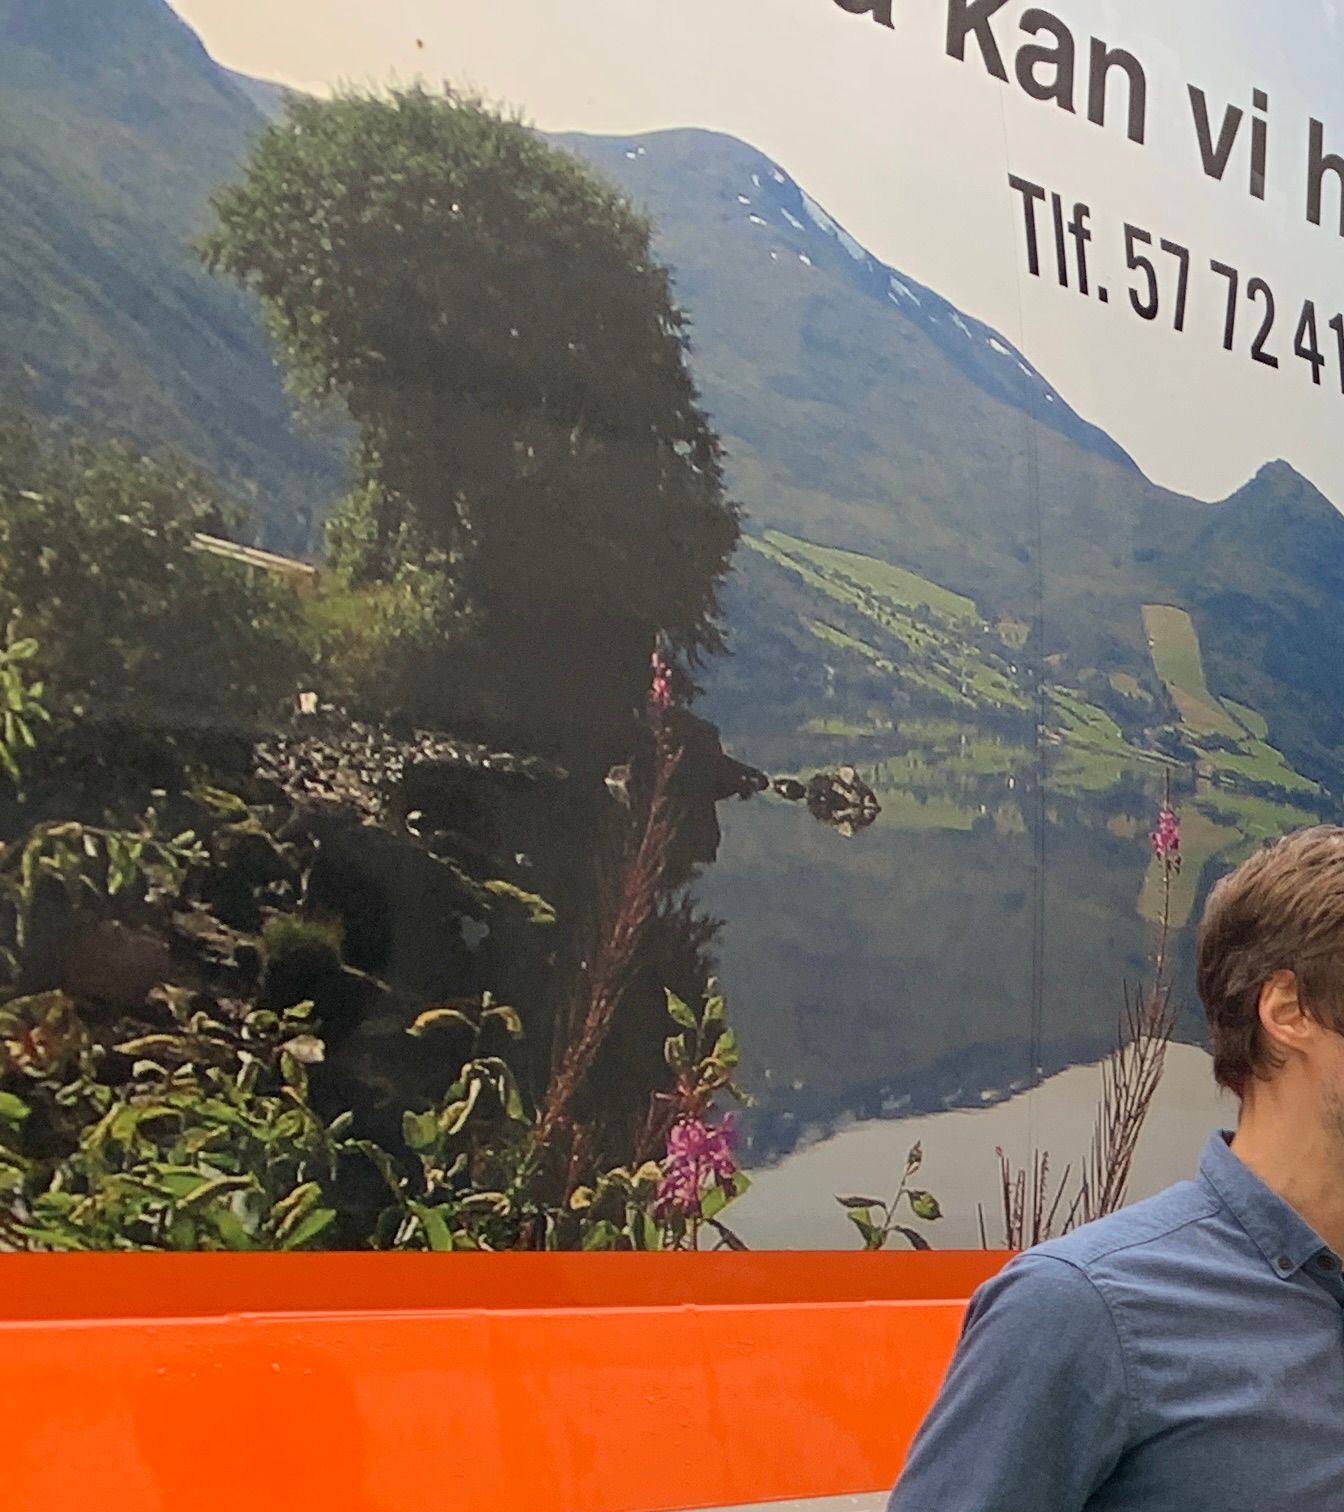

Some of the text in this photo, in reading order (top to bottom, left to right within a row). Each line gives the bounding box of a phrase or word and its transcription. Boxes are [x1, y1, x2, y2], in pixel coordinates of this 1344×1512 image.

[1187, 83, 1269, 201] vi
[1008, 172, 1109, 304] Tlf.
[1123, 222, 1189, 332] 57
[1209, 258, 1279, 369] 72
